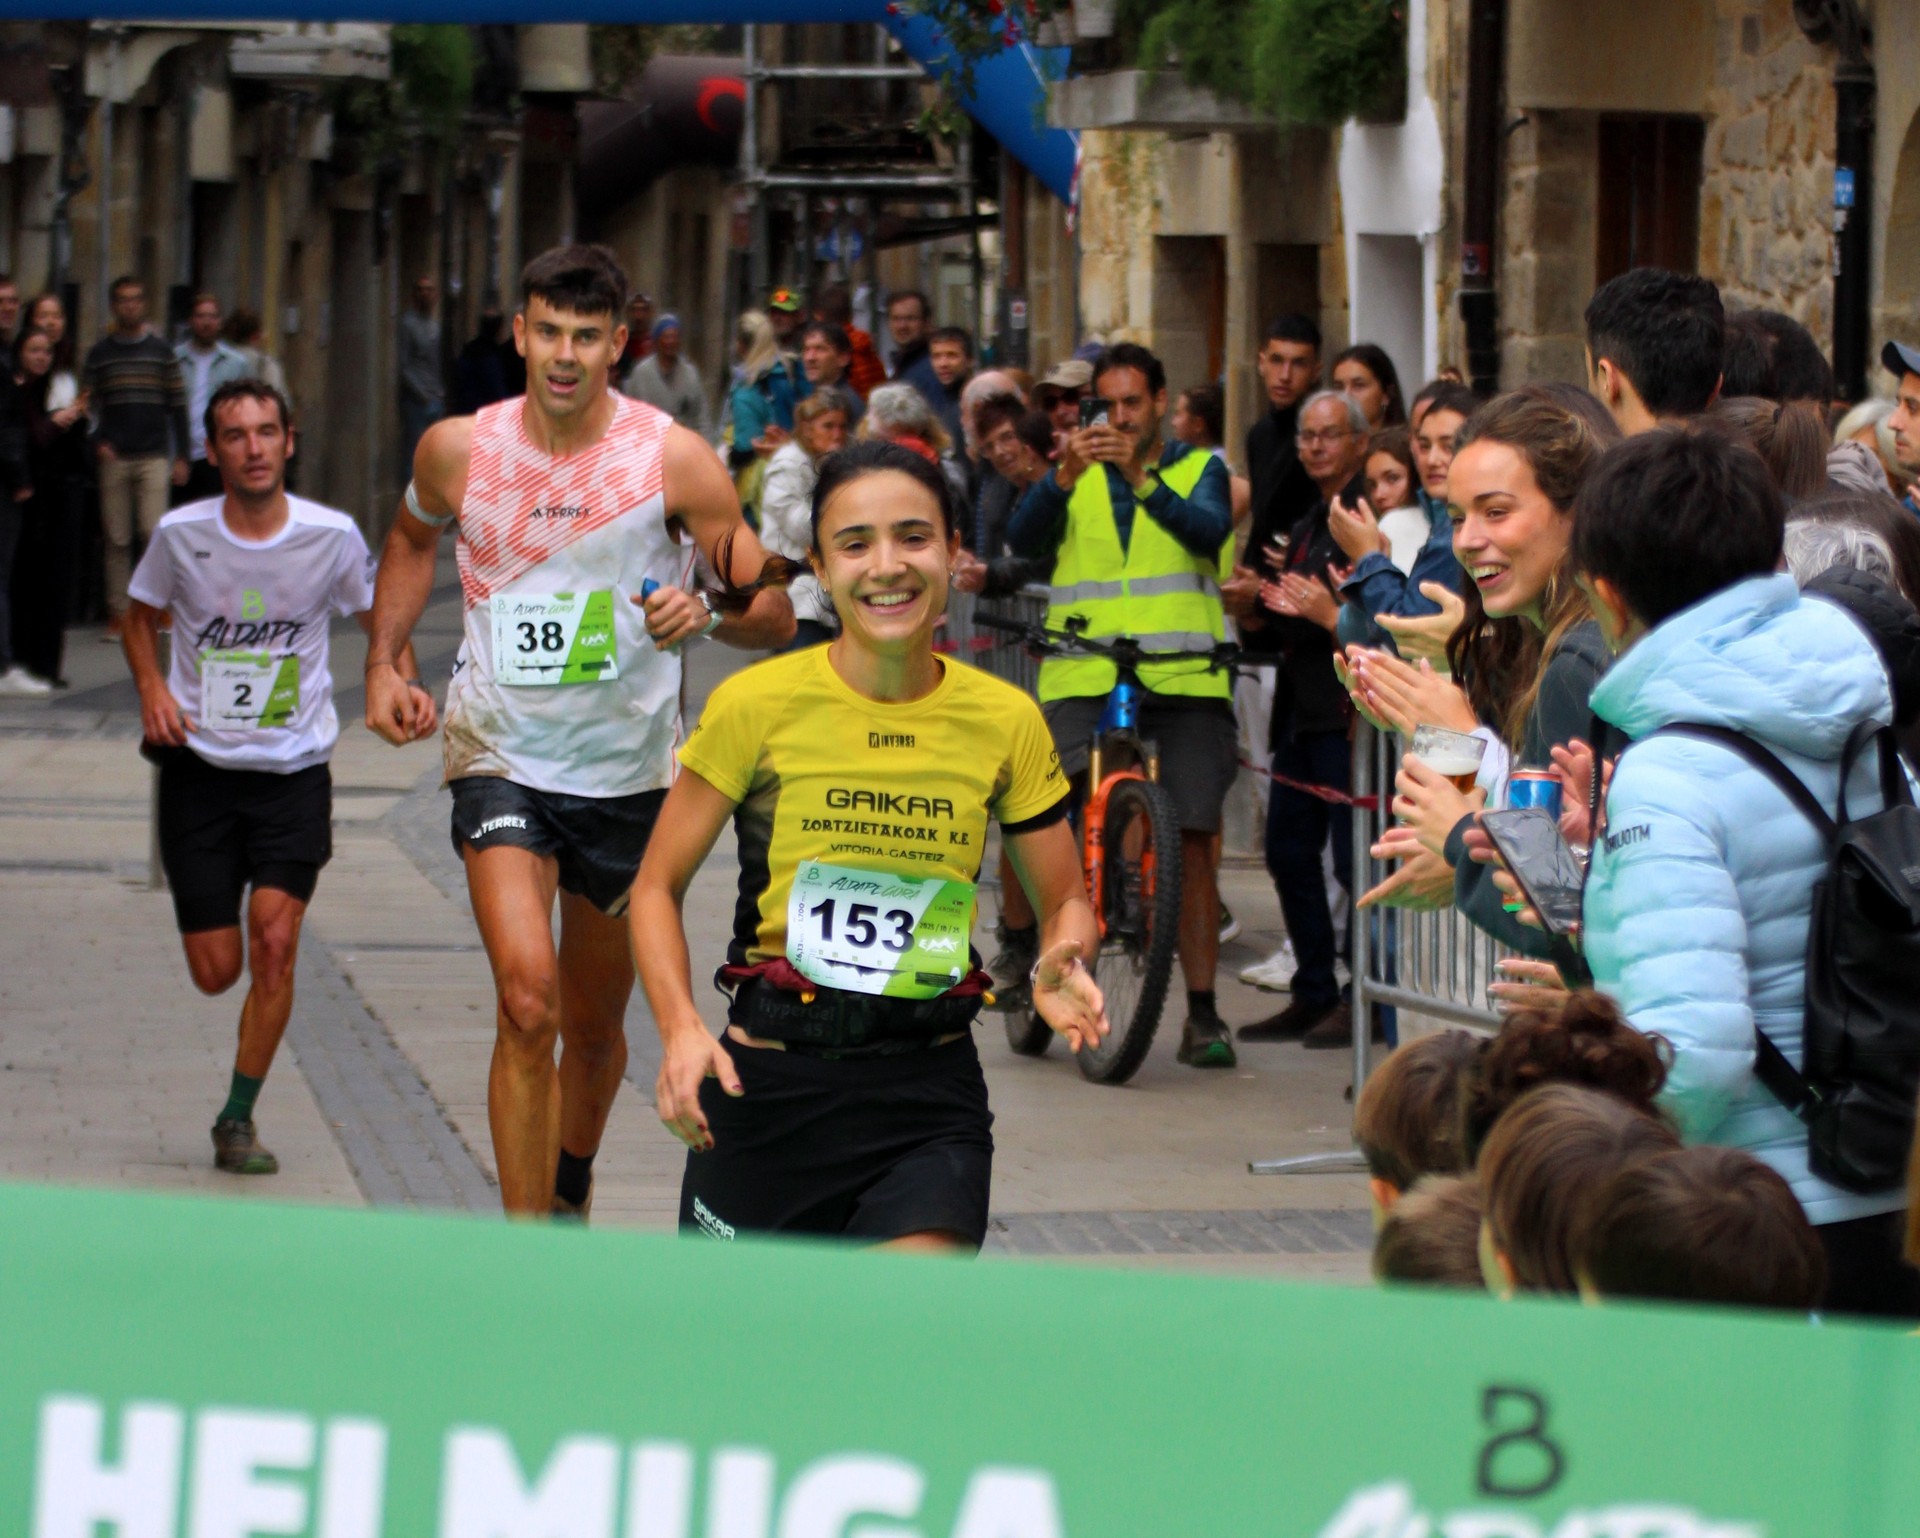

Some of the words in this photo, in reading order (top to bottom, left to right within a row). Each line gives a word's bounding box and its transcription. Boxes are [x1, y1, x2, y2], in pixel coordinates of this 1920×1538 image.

[546, 506, 590, 519] TERREX
[516, 621, 565, 653] 38
[232, 683, 252, 707] 2
[826, 788, 954, 820] GAIKAR
[481, 814, 527, 835] TERREX
[801, 819, 939, 842] ZORTZIETAKOAK
[830, 843, 946, 863] VITORIA-GASTEIZ
[810, 898, 915, 954] 153
[694, 1197, 736, 1241] GAIKAR
